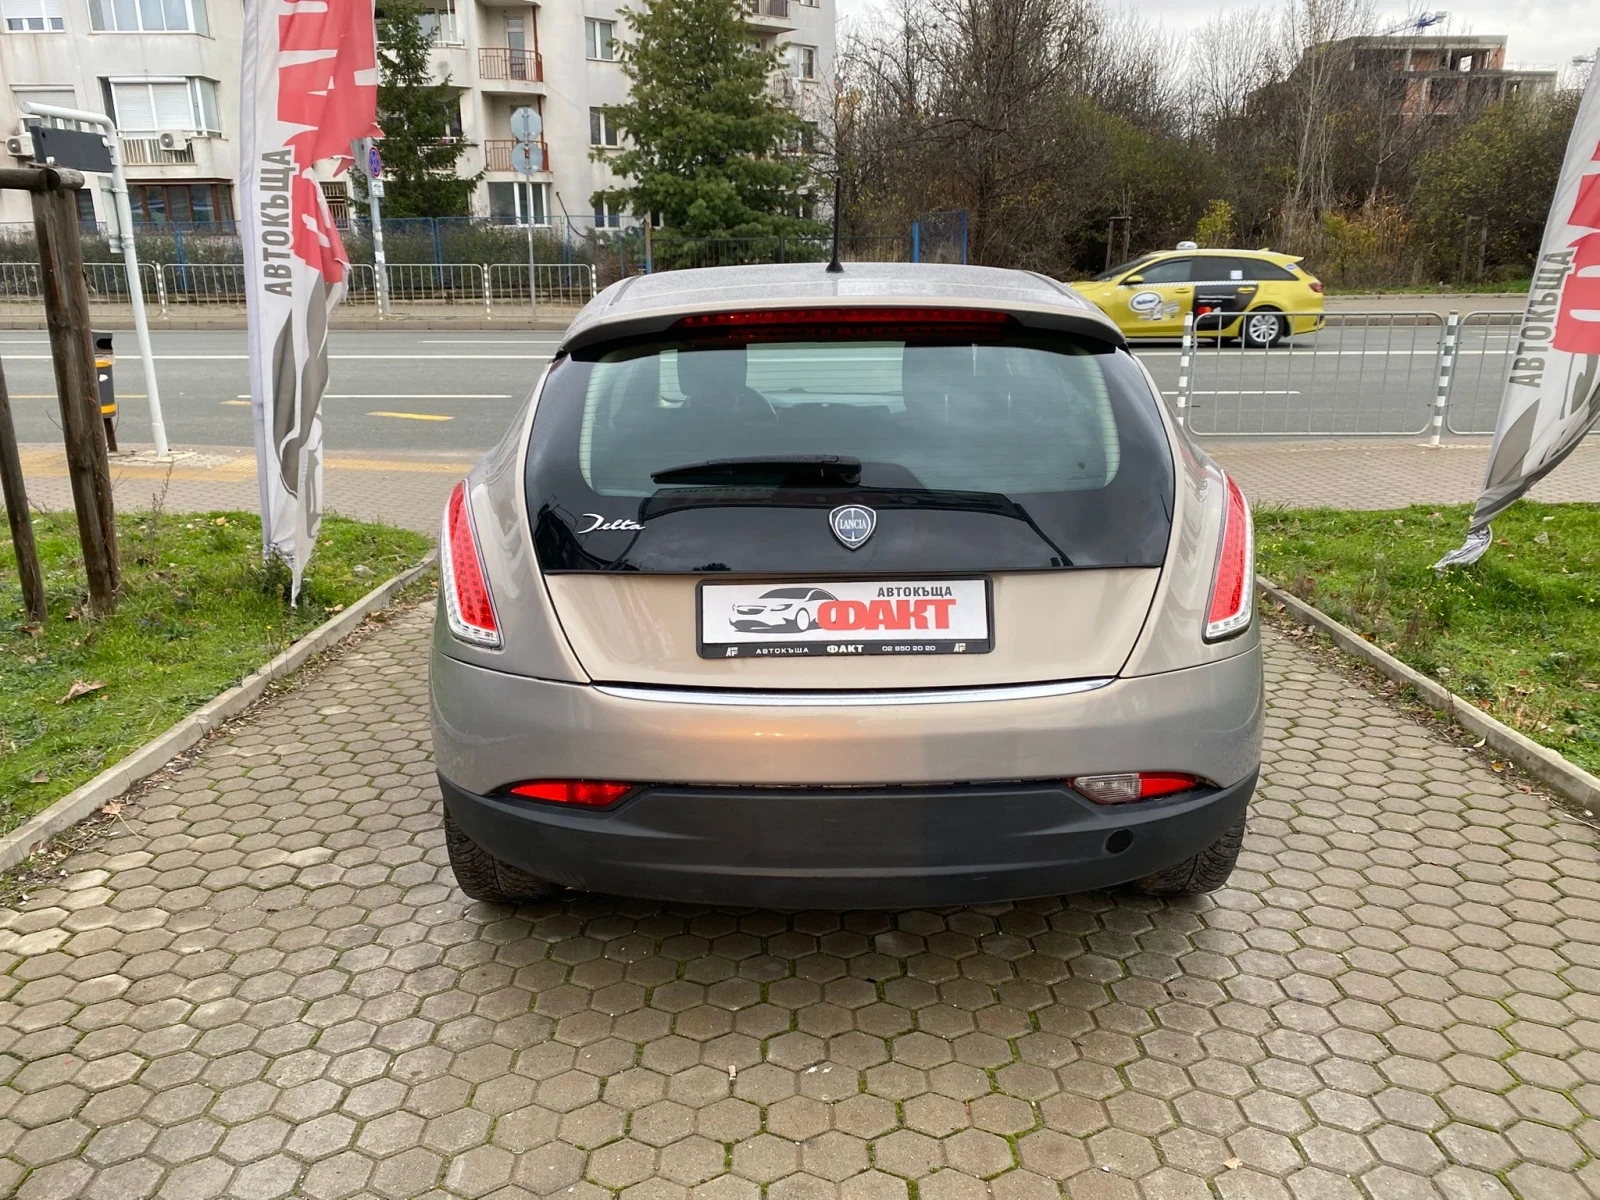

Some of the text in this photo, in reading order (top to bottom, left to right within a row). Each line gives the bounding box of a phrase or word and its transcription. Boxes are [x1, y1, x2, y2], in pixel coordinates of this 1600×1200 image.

[260, 149, 296, 297] АВТОКЪЩА
[1509, 250, 1575, 388] АВТОКЪЩА
[577, 513, 646, 534] Delta
[839, 518, 868, 530] LANCIA
[877, 586, 953, 598] АВТОКЪЩА
[817, 598, 957, 631] ФАКТ
[826, 644, 865, 653] ФАКТ
